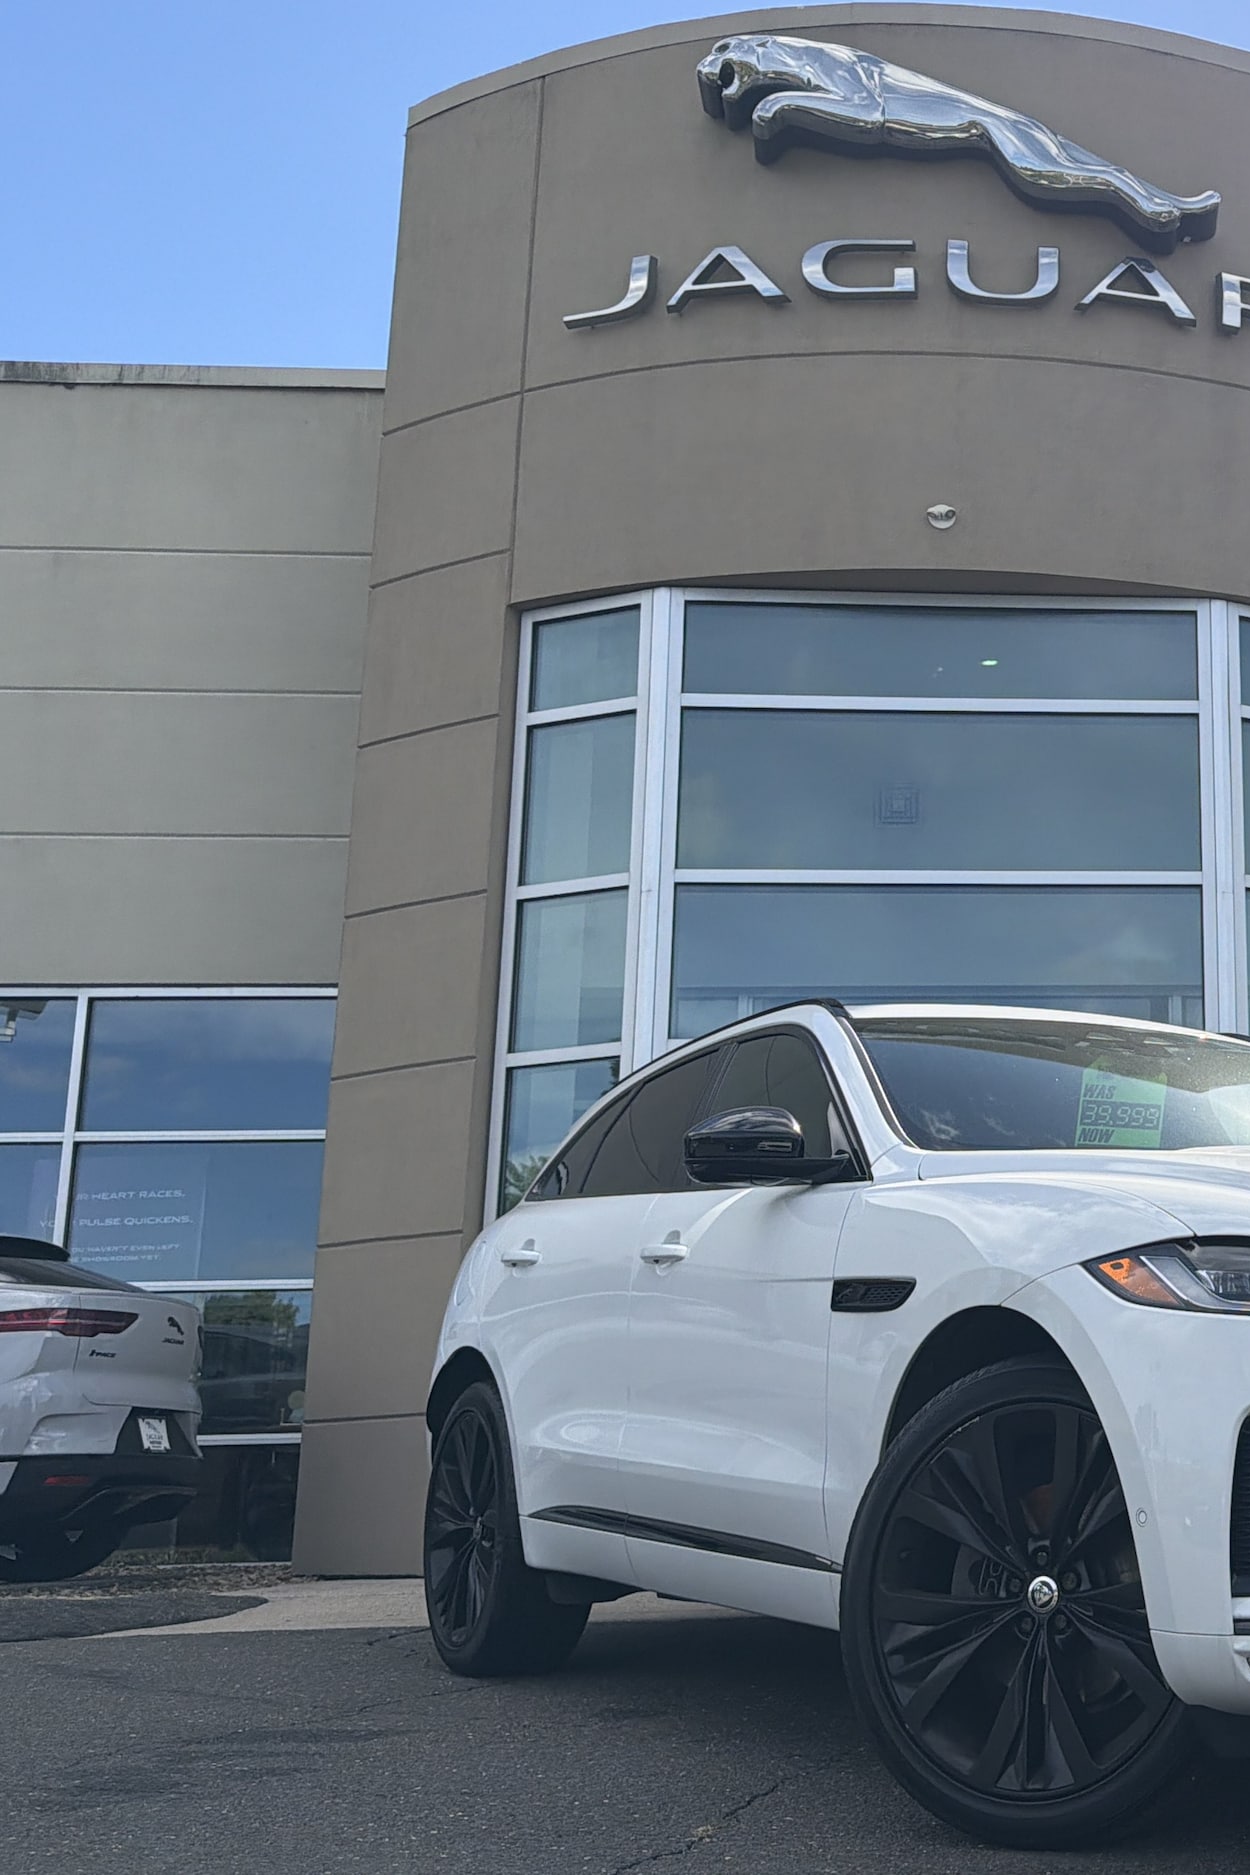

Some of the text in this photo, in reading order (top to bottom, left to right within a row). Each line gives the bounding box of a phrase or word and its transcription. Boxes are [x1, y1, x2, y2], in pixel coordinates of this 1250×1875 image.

[1082, 1084, 1116, 1100] WAS
[1078, 1127, 1115, 1144] NOW
[91, 1191, 136, 1200] HEART
[138, 1189, 186, 1199] RACES.
[79, 1218, 121, 1227] PULSE
[123, 1215, 194, 1226] QUICKENS.
